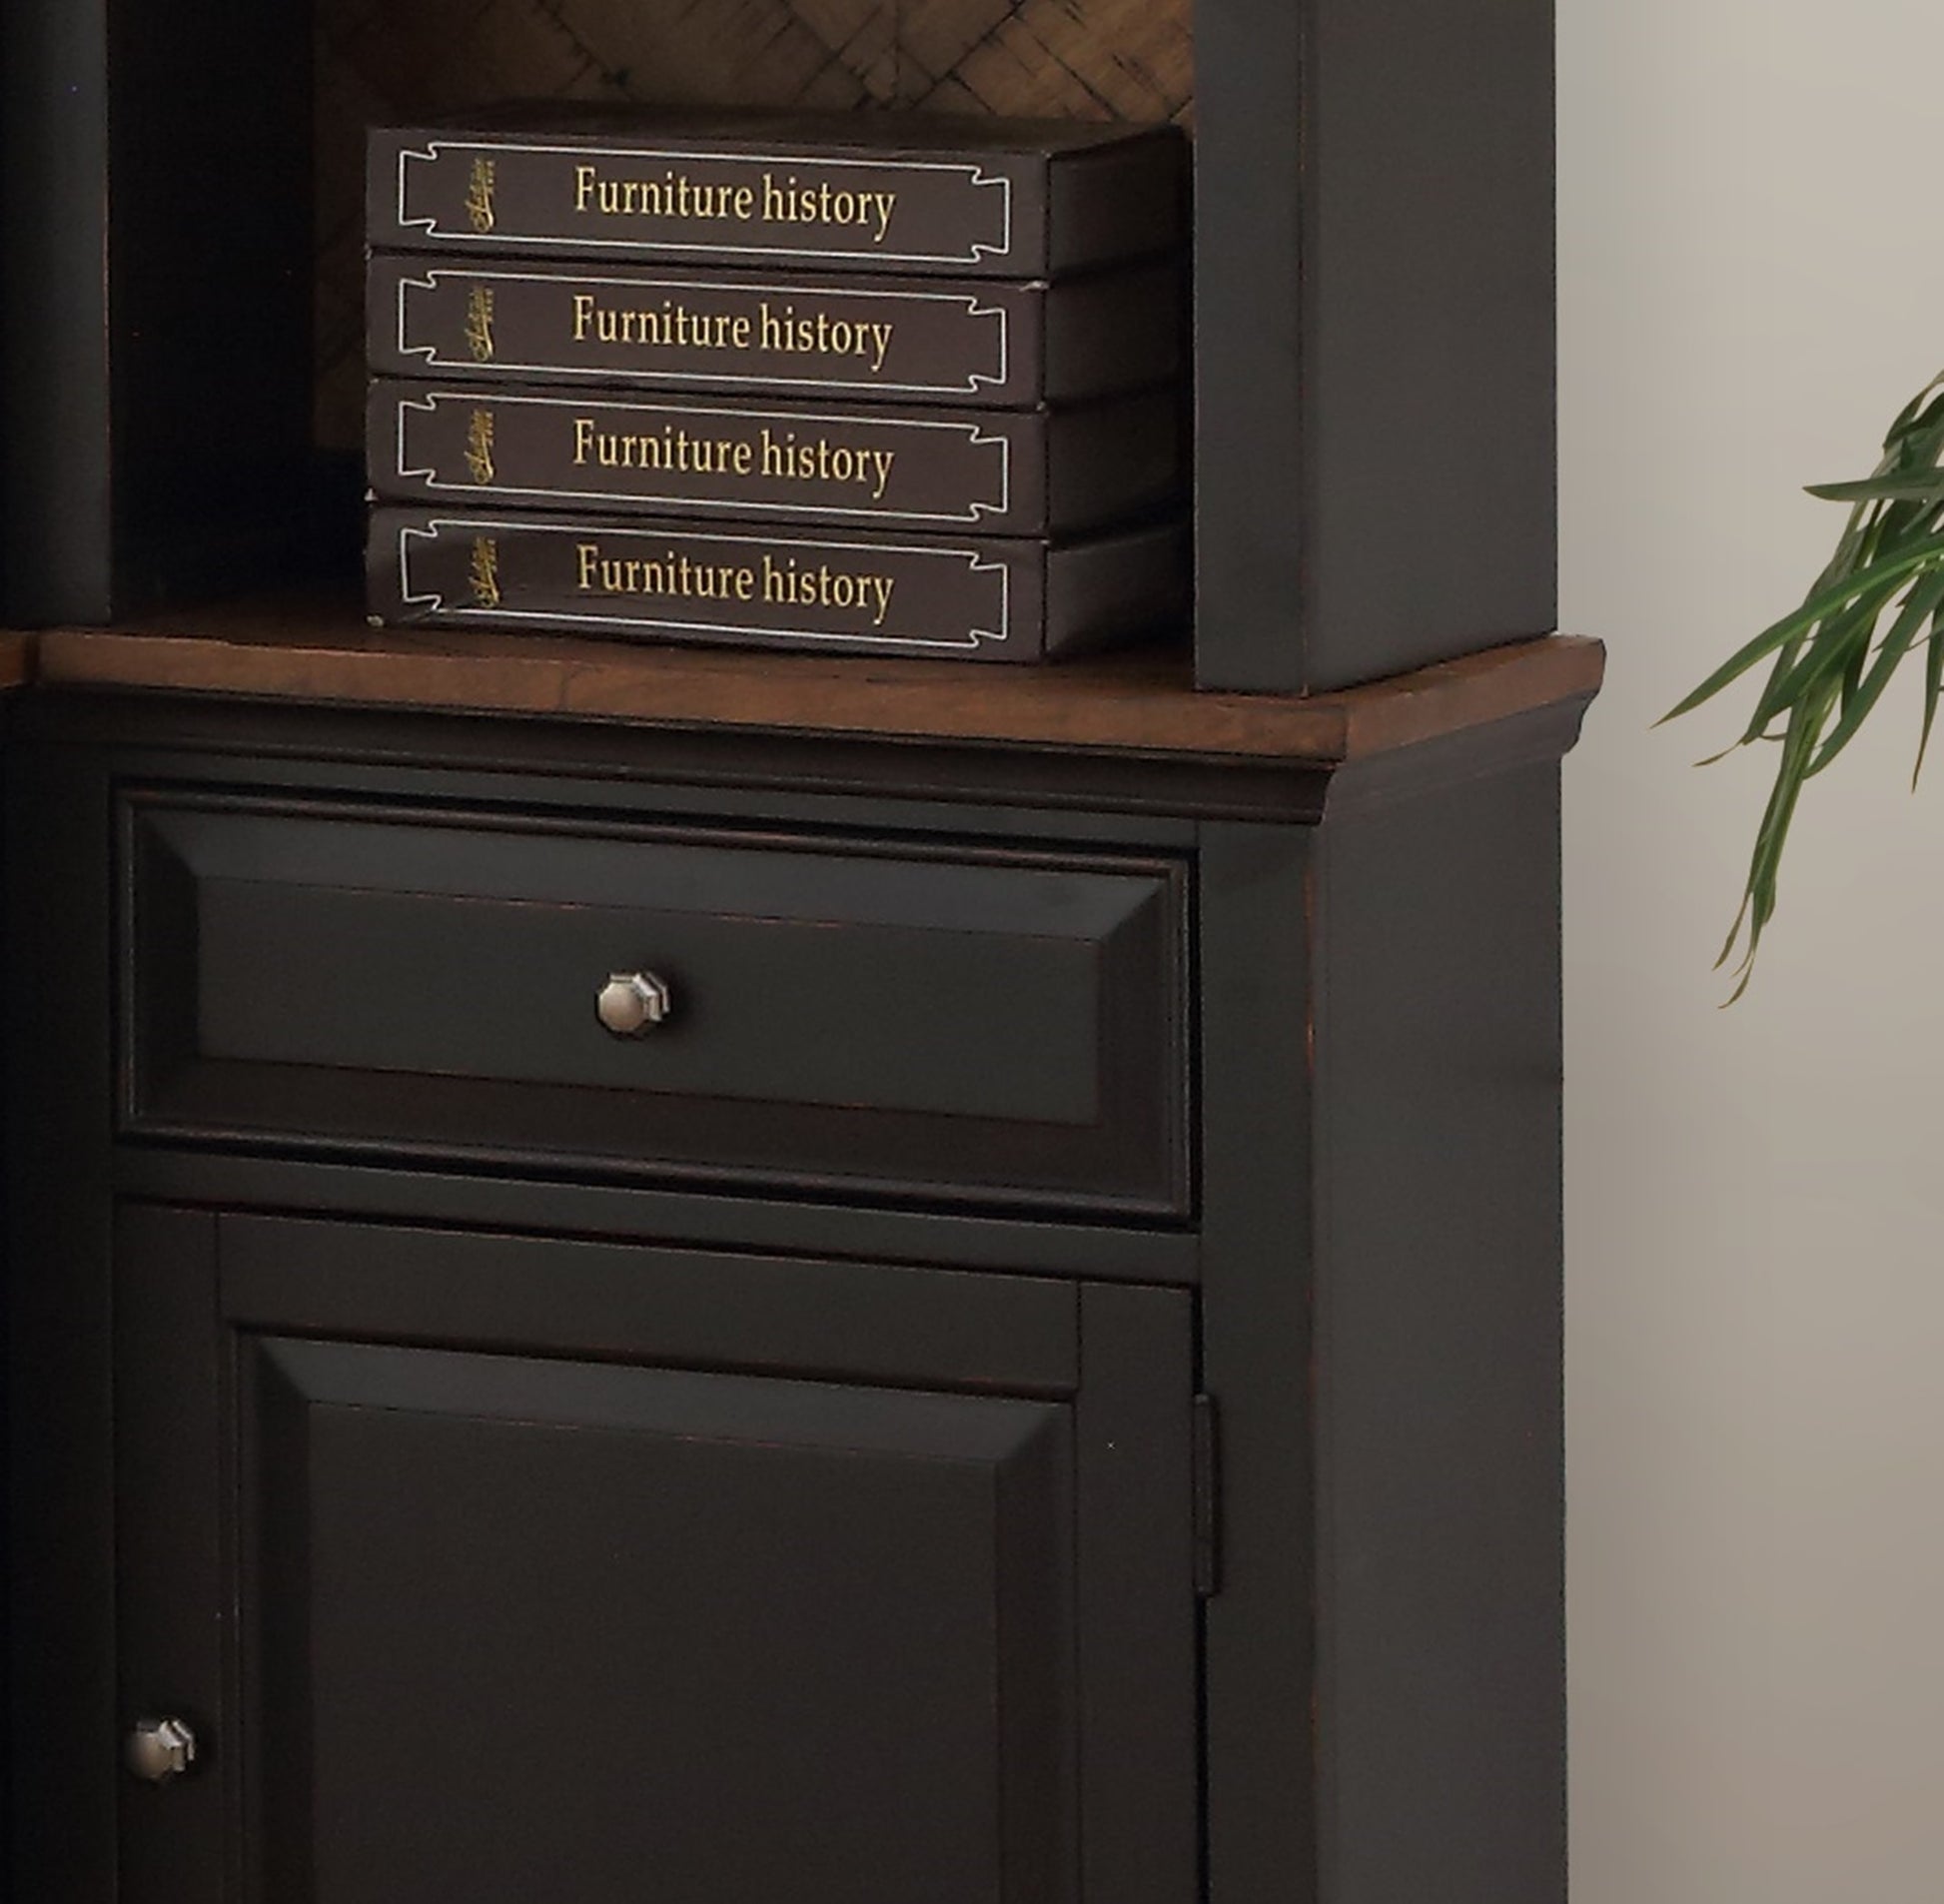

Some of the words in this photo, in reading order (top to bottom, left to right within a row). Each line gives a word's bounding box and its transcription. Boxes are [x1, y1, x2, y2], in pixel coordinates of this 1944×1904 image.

[576, 165, 754, 221] Furniture
[761, 172, 897, 242] history
[573, 294, 751, 349] Furniture
[758, 302, 892, 372] history
[574, 418, 752, 476] Furniture
[759, 428, 894, 498] history
[576, 543, 754, 601] Furniture
[762, 553, 895, 624] history
